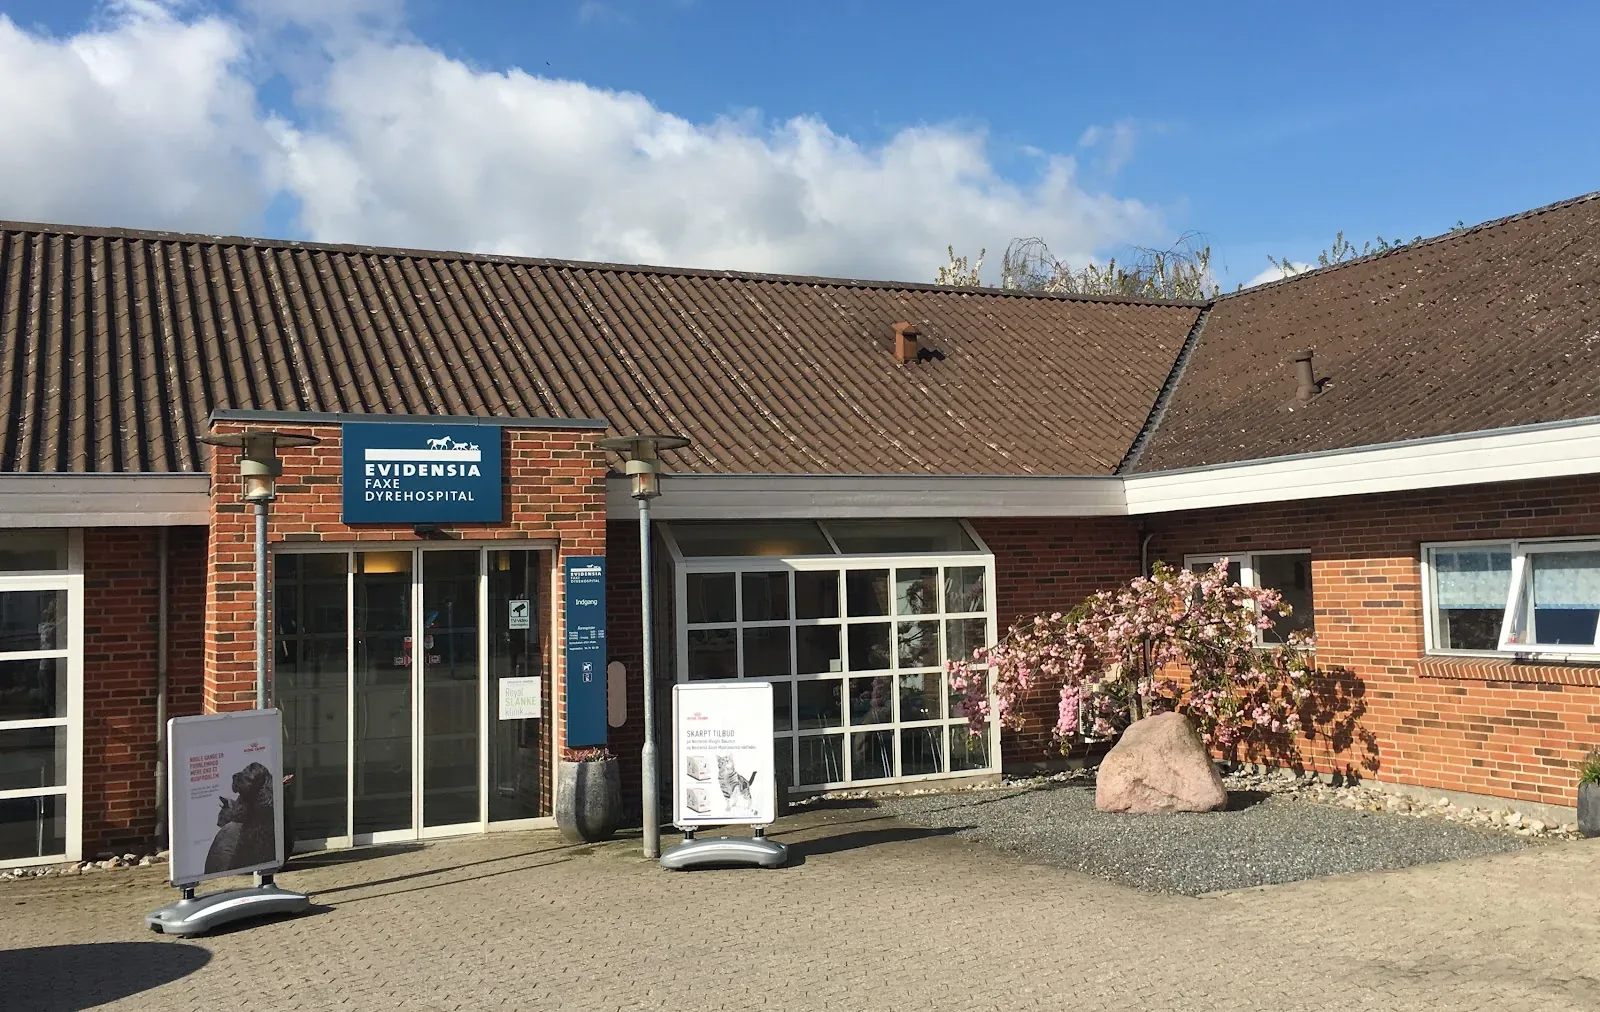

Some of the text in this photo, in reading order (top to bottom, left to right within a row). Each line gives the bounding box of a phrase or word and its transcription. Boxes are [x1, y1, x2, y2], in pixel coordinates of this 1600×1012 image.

[365, 463, 481, 477] EVIDENSIA
[365, 478, 400, 489] FAXE
[365, 491, 475, 502] DYREHOSPITAL
[505, 687, 524, 699] Royal
[505, 696, 537, 707] SLANKE
[686, 729, 735, 738] SKARPT TILBUD
